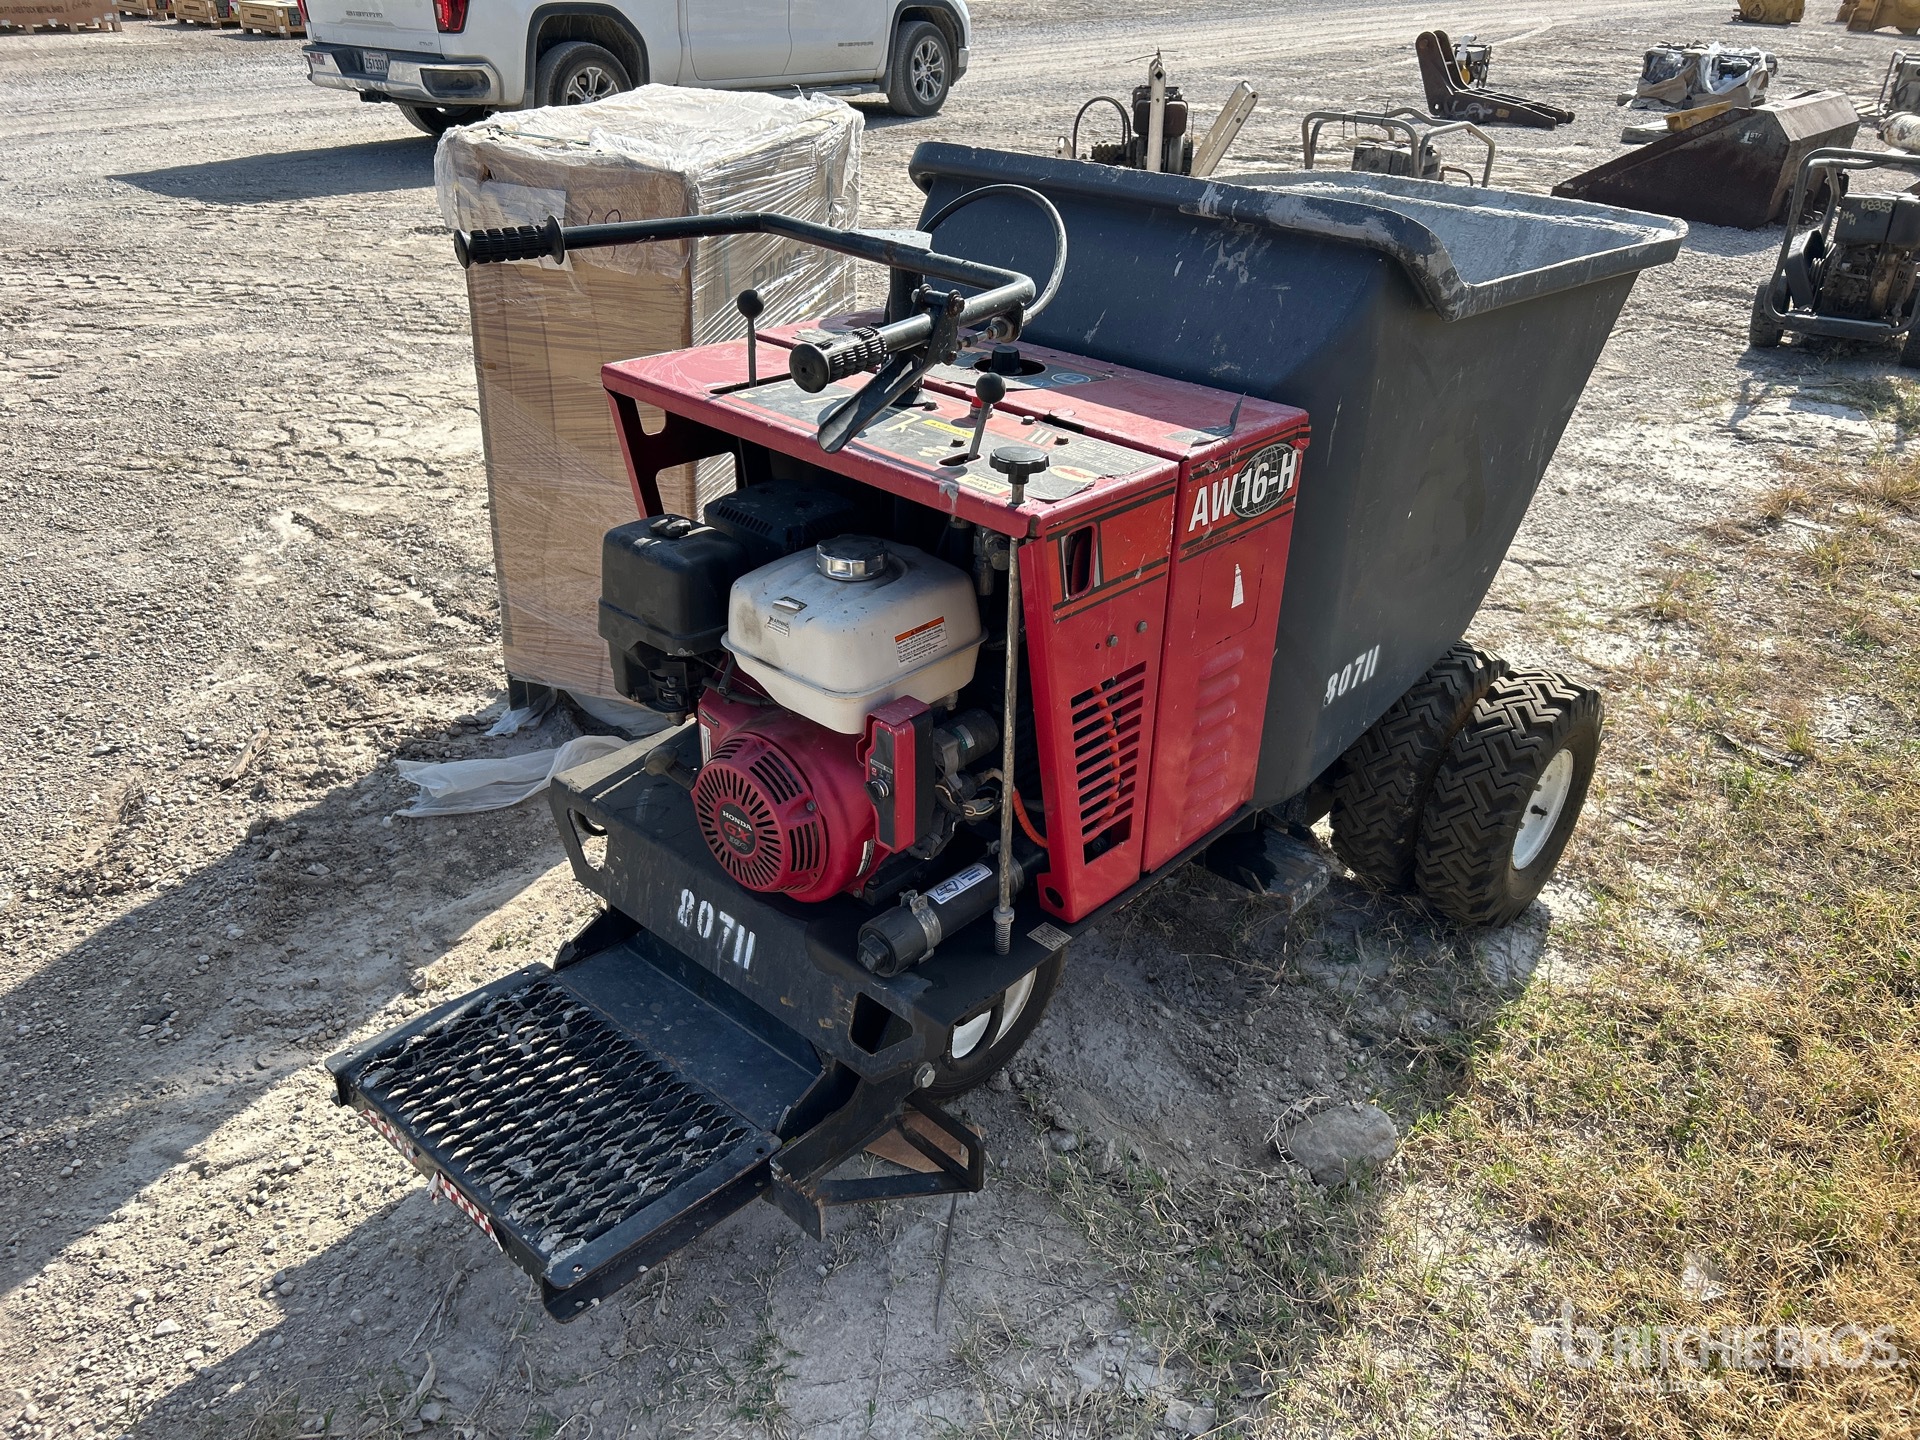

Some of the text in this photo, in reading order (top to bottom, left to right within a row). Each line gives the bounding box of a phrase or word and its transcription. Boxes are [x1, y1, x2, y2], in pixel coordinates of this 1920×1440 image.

[1860, 199, 1893, 213] 68353
[1187, 448, 1298, 532] AW16-H
[1323, 645, 1380, 707] 80711
[722, 810, 753, 832] HONDA
[723, 821, 752, 845] GX
[677, 888, 757, 970] 80711
